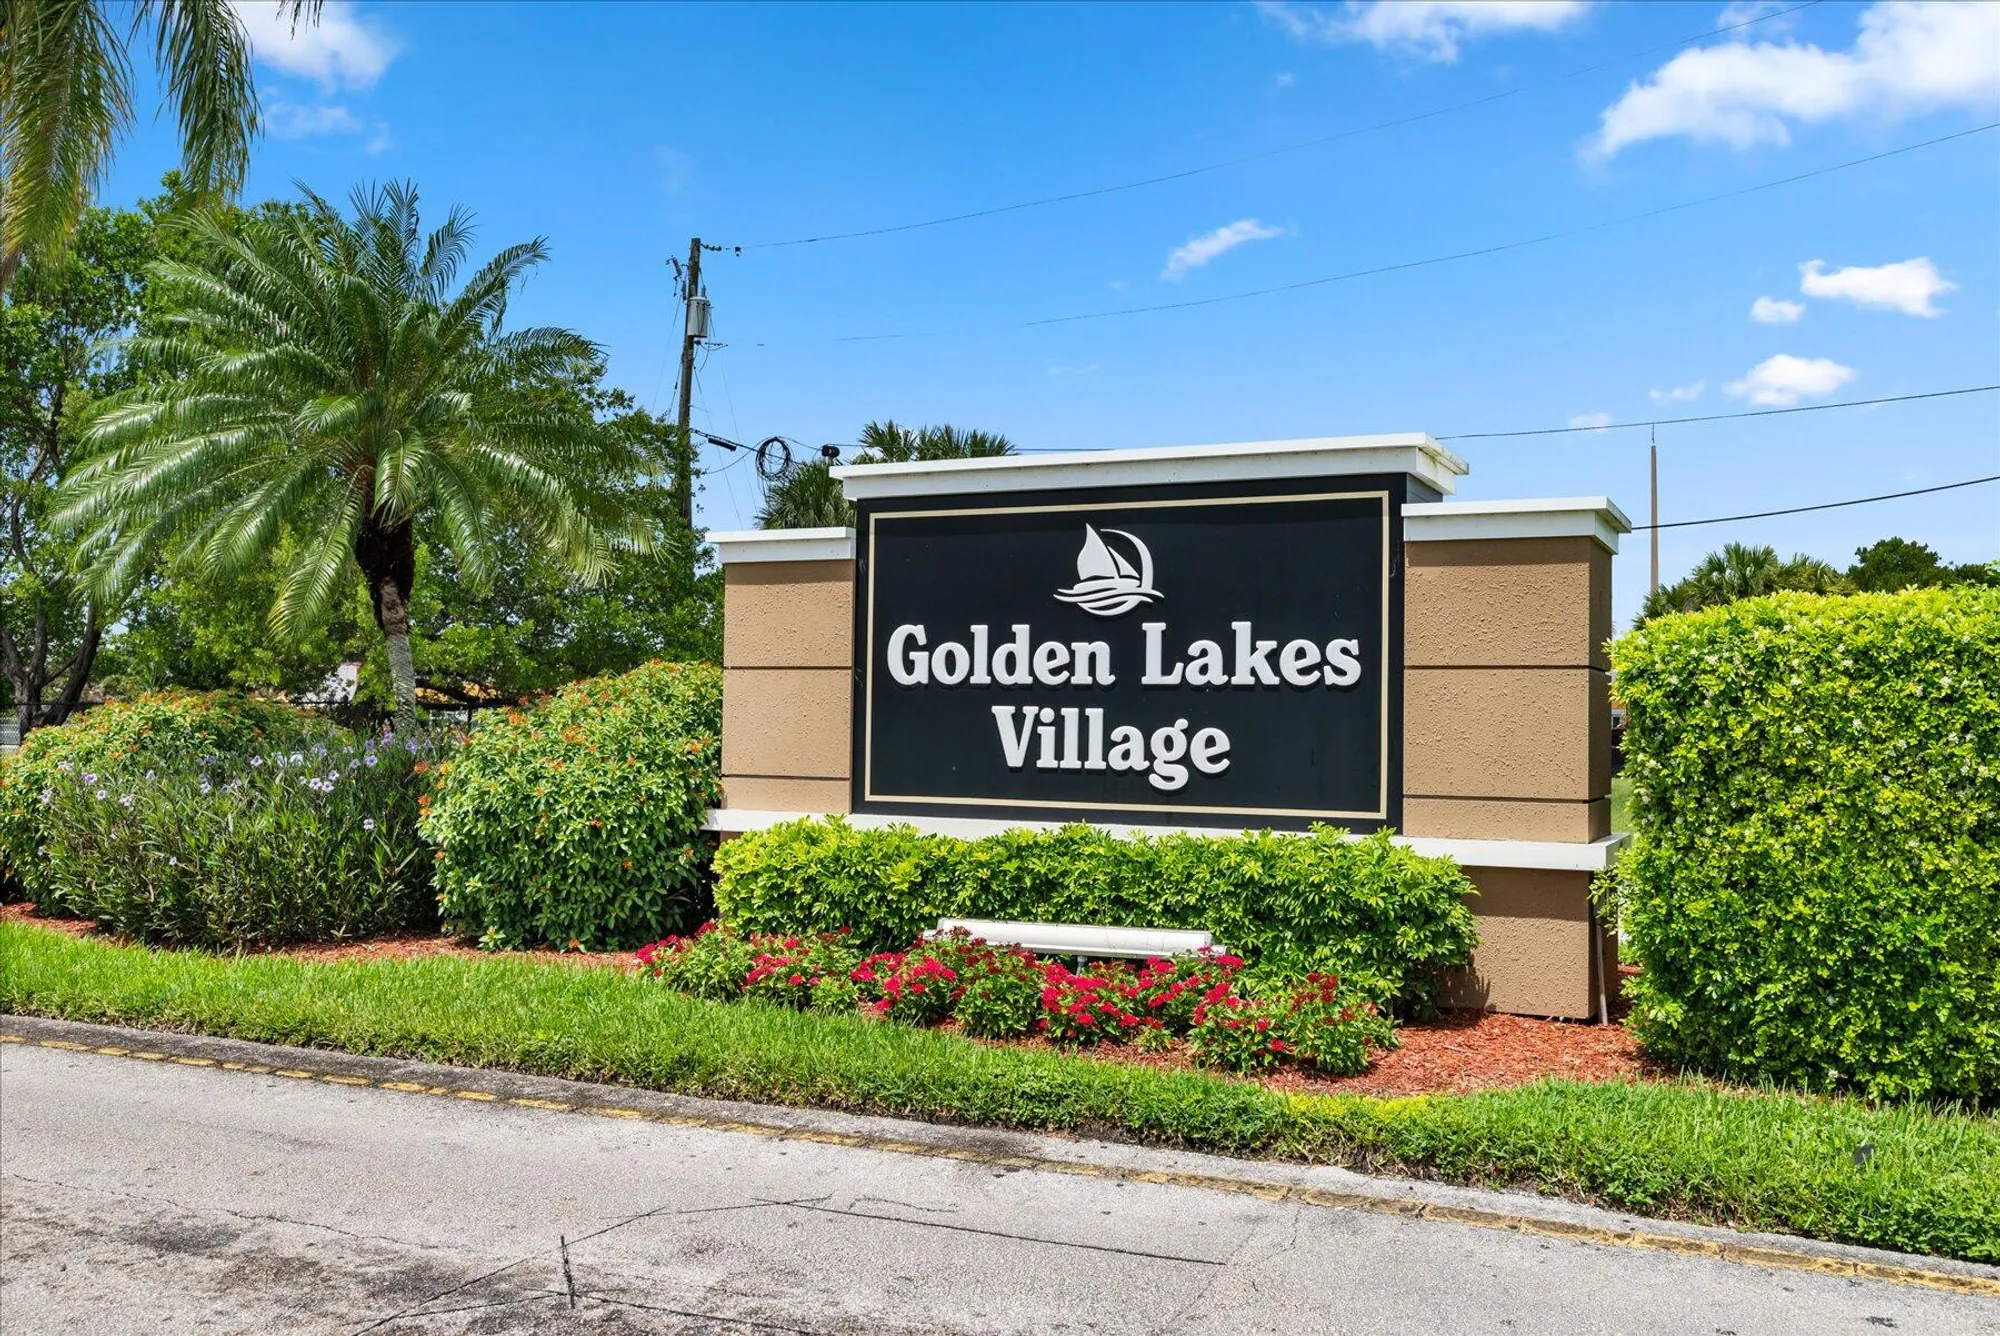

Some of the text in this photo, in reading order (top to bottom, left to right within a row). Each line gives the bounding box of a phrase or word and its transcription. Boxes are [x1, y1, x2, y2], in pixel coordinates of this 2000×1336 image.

[887, 620, 1362, 686] Golden Lakes
[991, 705, 1231, 791] Village
